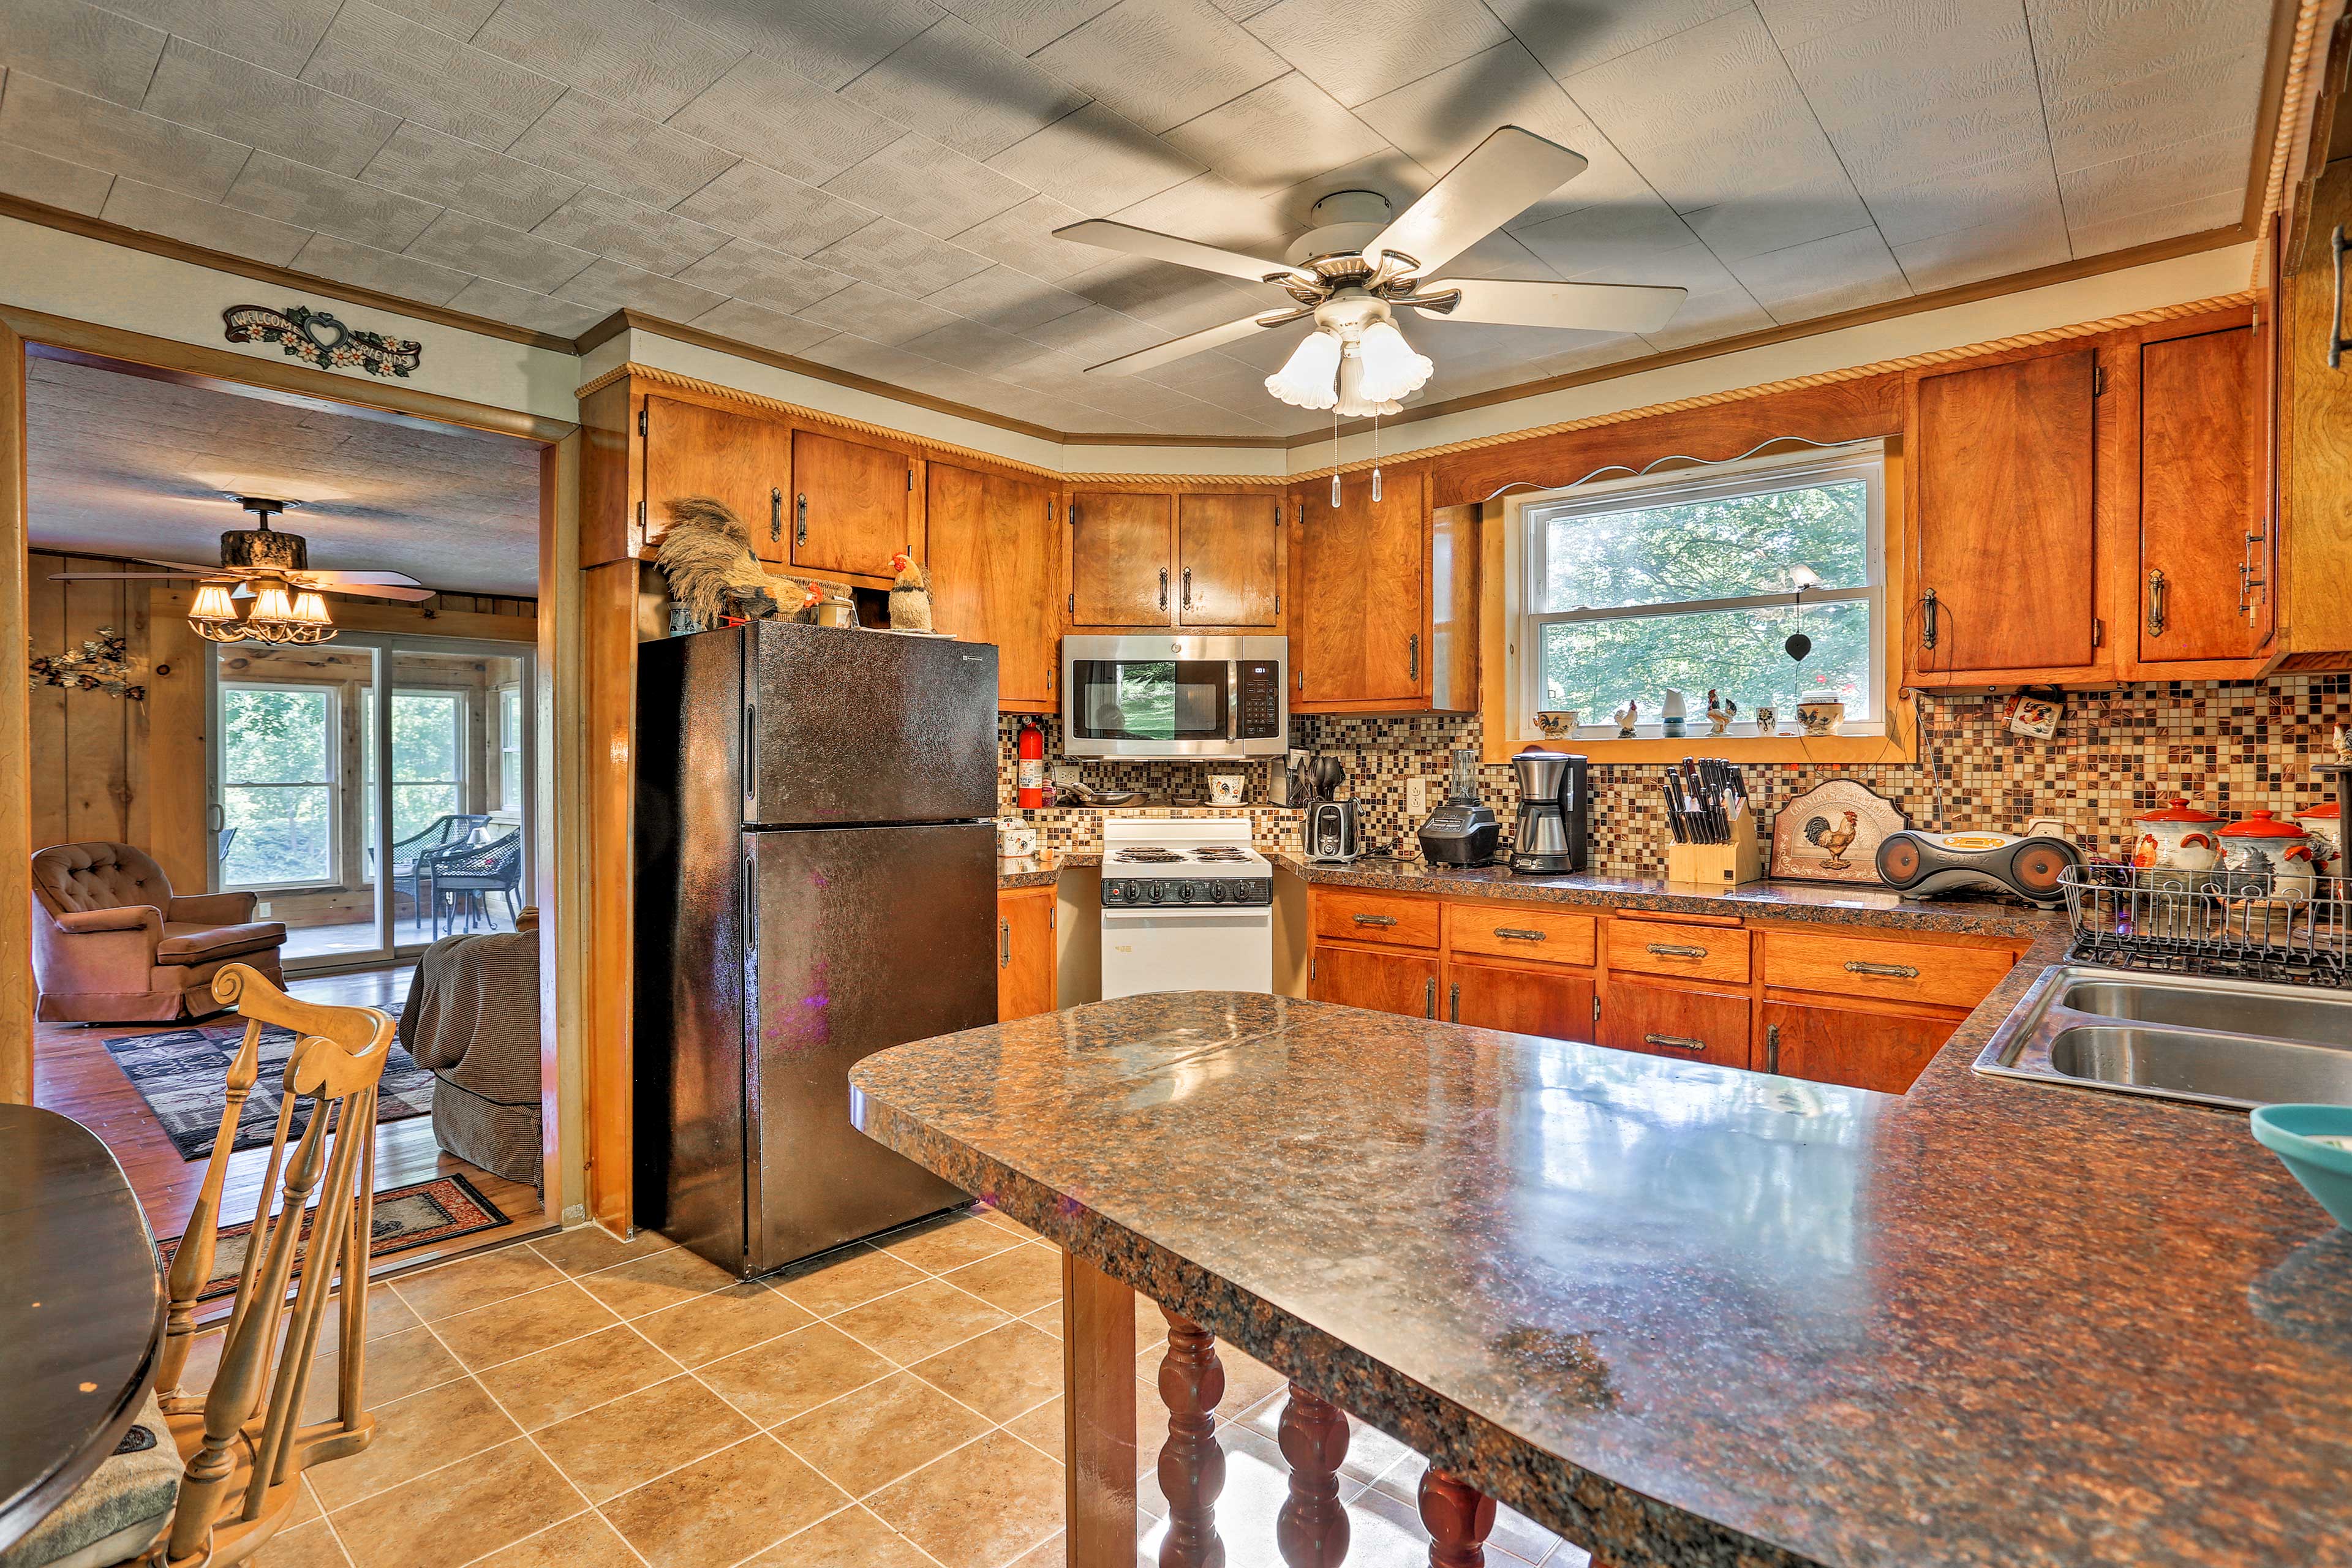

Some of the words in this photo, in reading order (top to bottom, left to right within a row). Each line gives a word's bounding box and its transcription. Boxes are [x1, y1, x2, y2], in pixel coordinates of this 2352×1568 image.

[233, 310, 301, 334] WELCOME
[352, 341, 410, 366] FRIENDS
[1936, 853, 1991, 864] SONY
